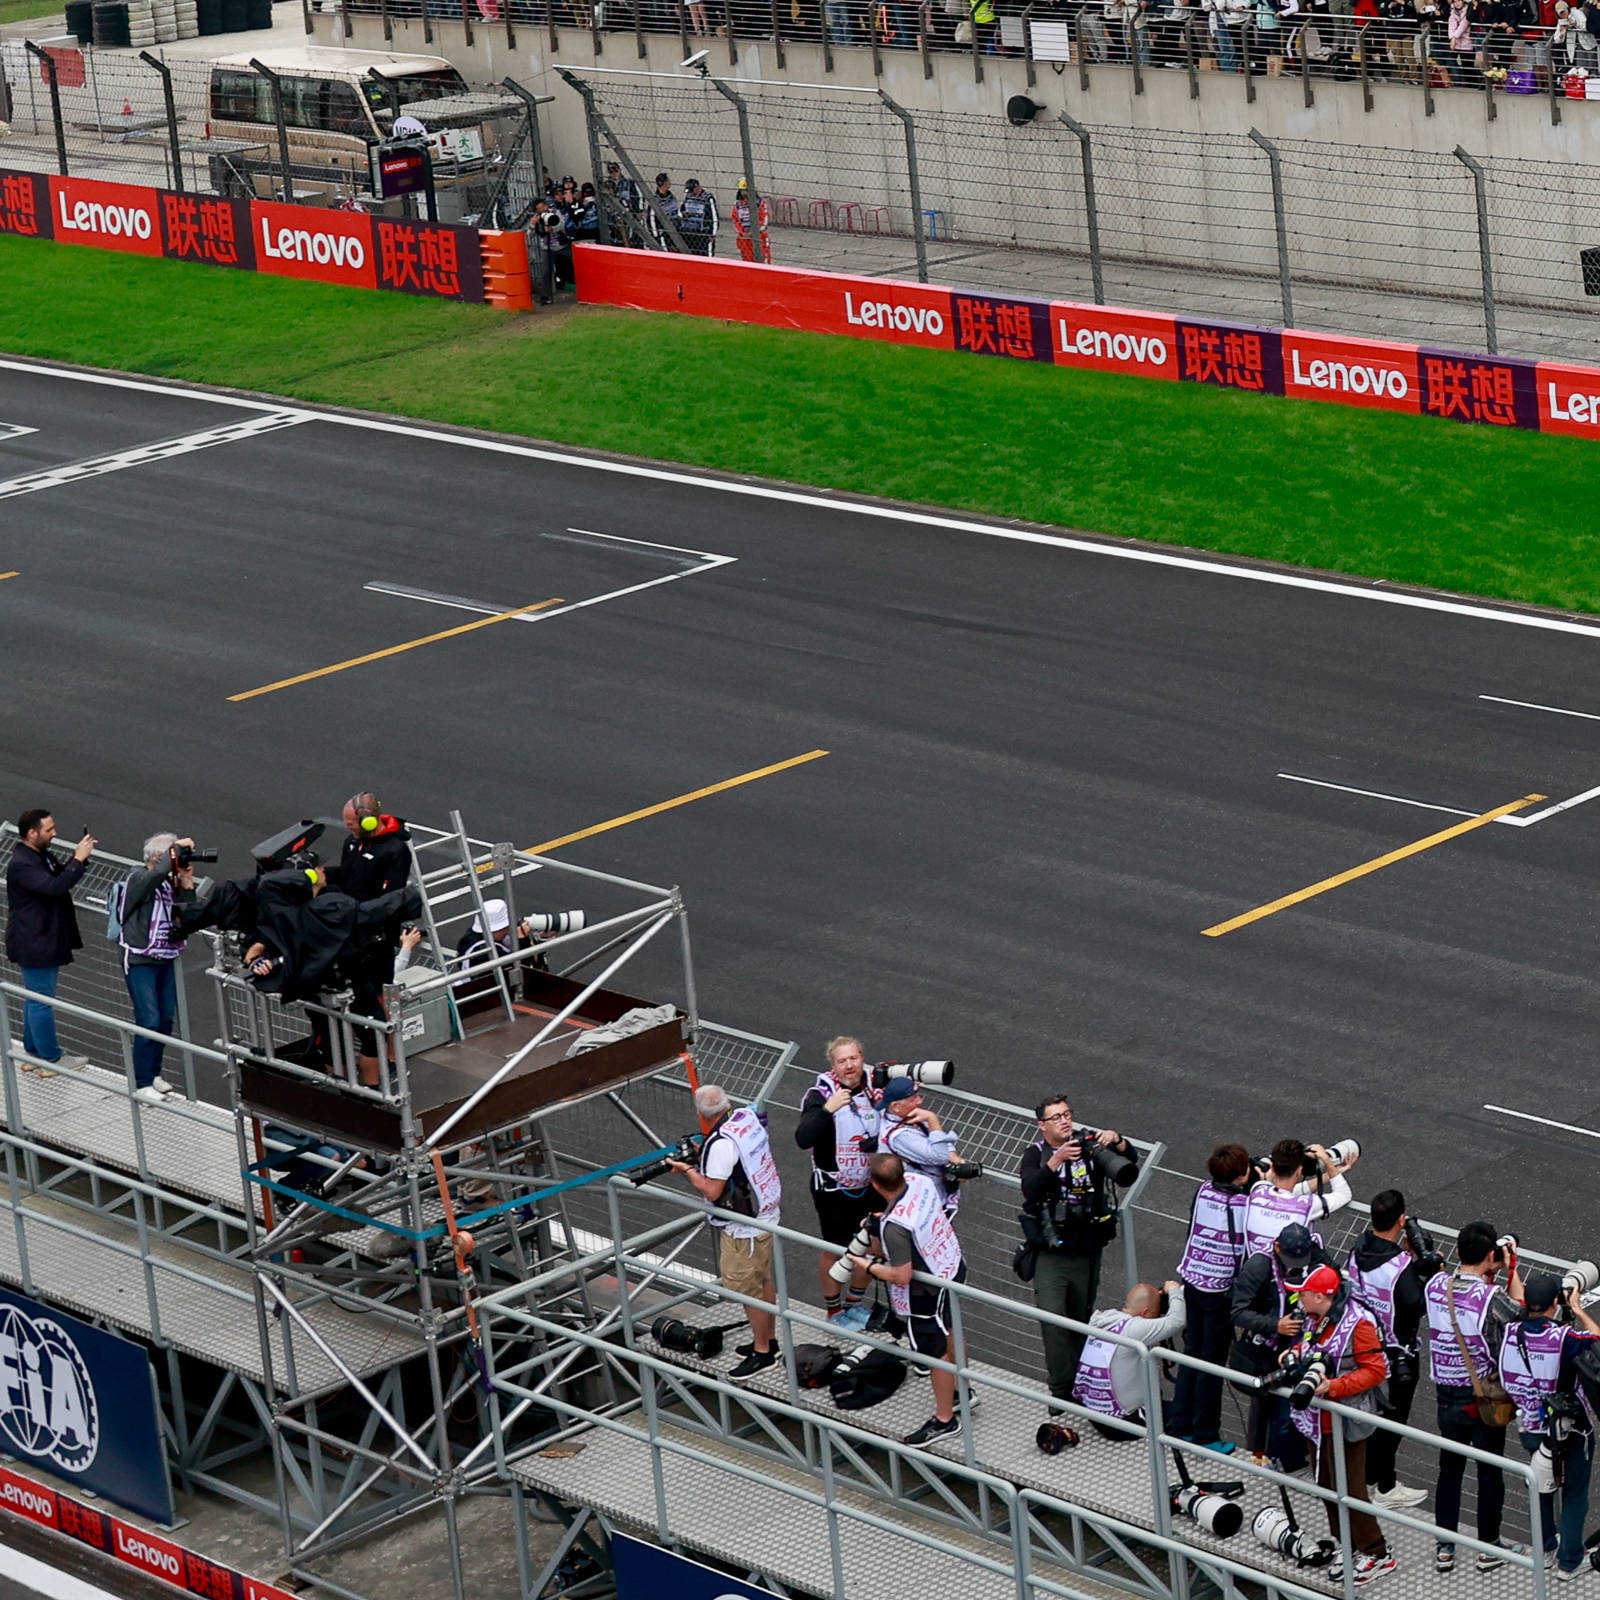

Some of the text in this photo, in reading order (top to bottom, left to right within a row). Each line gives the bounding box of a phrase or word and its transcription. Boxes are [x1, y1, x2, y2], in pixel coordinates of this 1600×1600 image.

[0, 174, 38, 235] 想
[58, 191, 152, 240] Lenovo
[163, 194, 239, 264] 联想
[261, 217, 364, 270] Lenovo
[378, 222, 461, 295] 联想
[844, 291, 944, 337] Lenovo
[956, 298, 1034, 358] 联想
[1059, 318, 1167, 366] Lenovo
[1182, 326, 1264, 390] 联想
[1292, 349, 1408, 400] Lenovo
[1424, 357, 1516, 425] 联想
[1201, 1252, 1236, 1265] MEDIA
[0, 1482, 52, 1518] enovo
[117, 1528, 180, 1576] Lenovo
